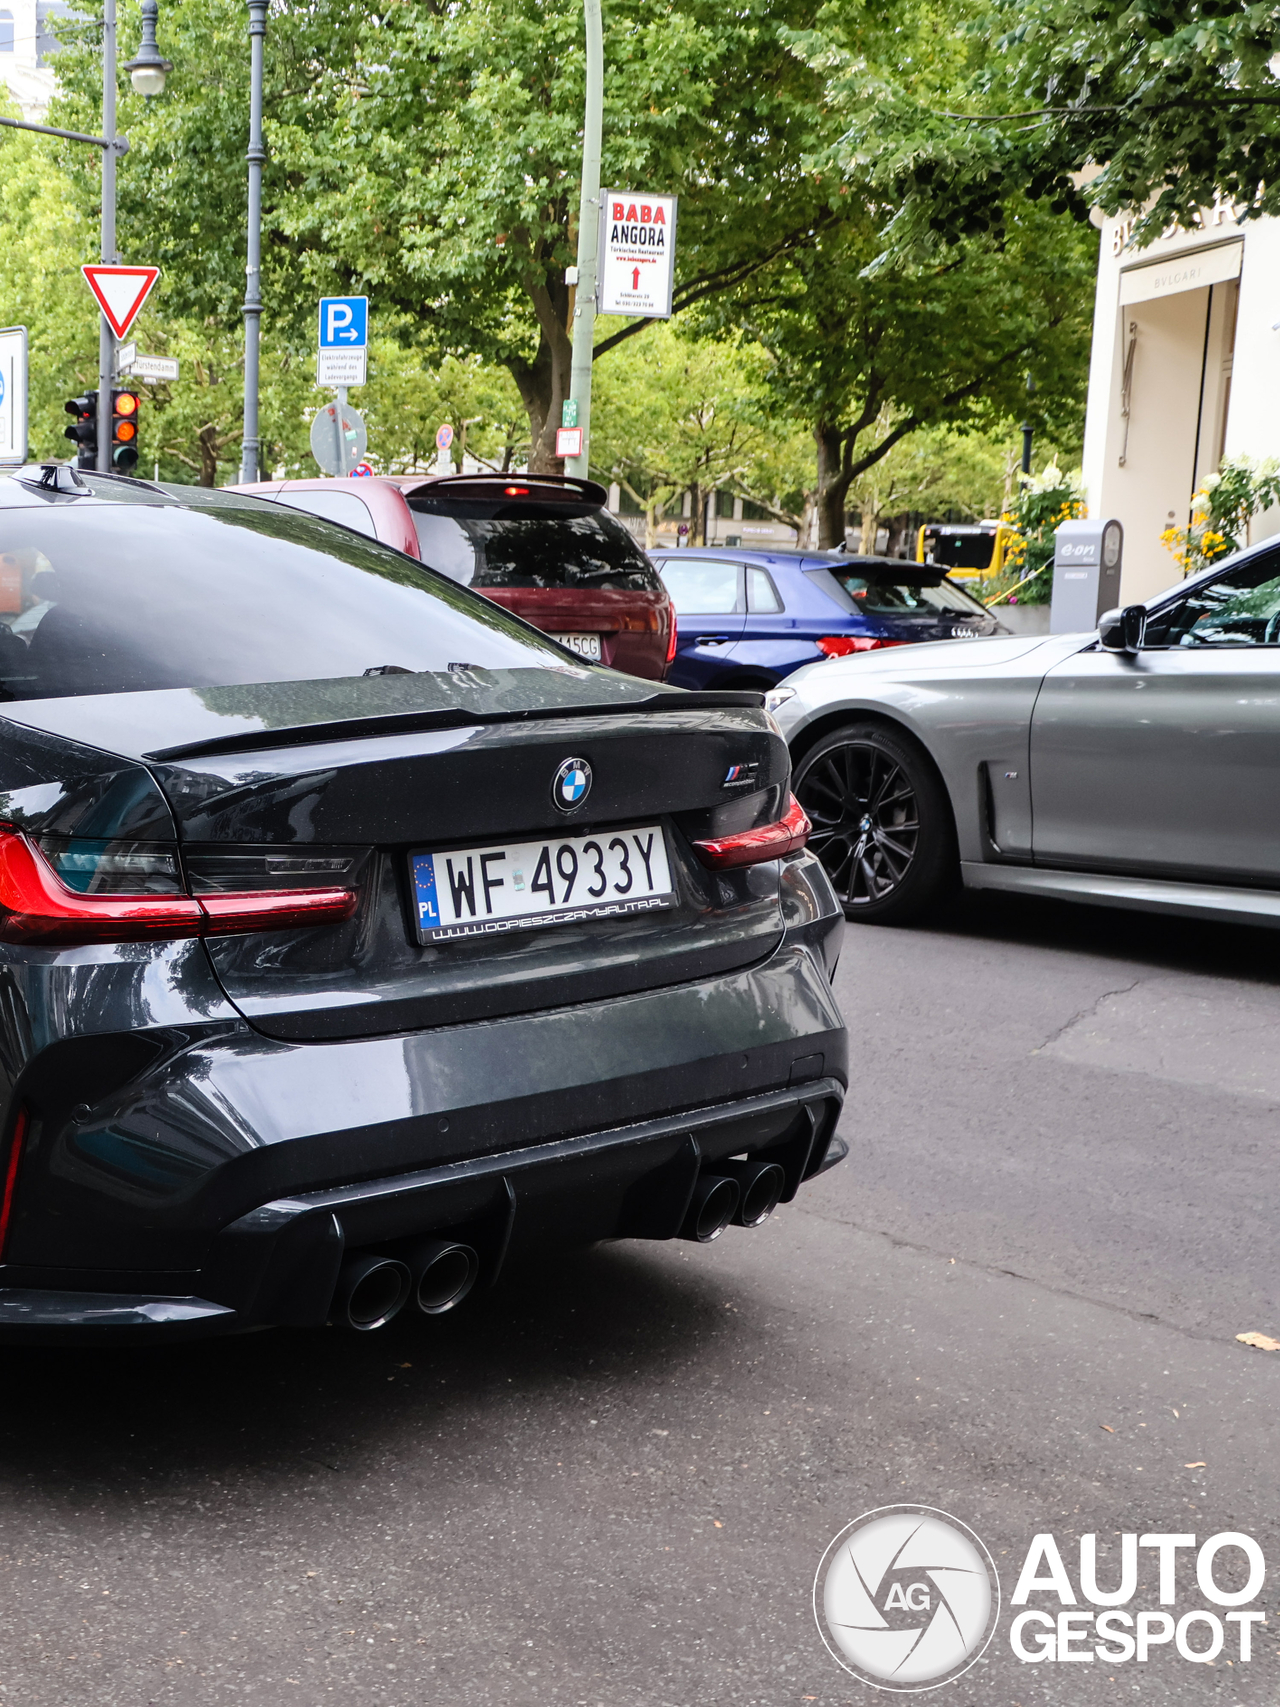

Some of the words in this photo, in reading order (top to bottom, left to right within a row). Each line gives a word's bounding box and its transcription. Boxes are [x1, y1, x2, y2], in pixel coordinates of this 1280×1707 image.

[613, 202, 666, 225] BABA
[611, 224, 665, 247] ANGORA
[610, 246, 637, 254] Türkisches
[638, 248, 665, 256] Restaurant
[1154, 267, 1202, 289] BVLGARI
[327, 303, 353, 342] P
[321, 354, 362, 362] Elektrofahrzeuge
[324, 373, 358, 381] Ladevorgangs
[560, 760, 592, 779] BMW
[445, 851, 507, 919] WF
[531, 833, 654, 905] 4933Y
[419, 901, 437, 919] PL
